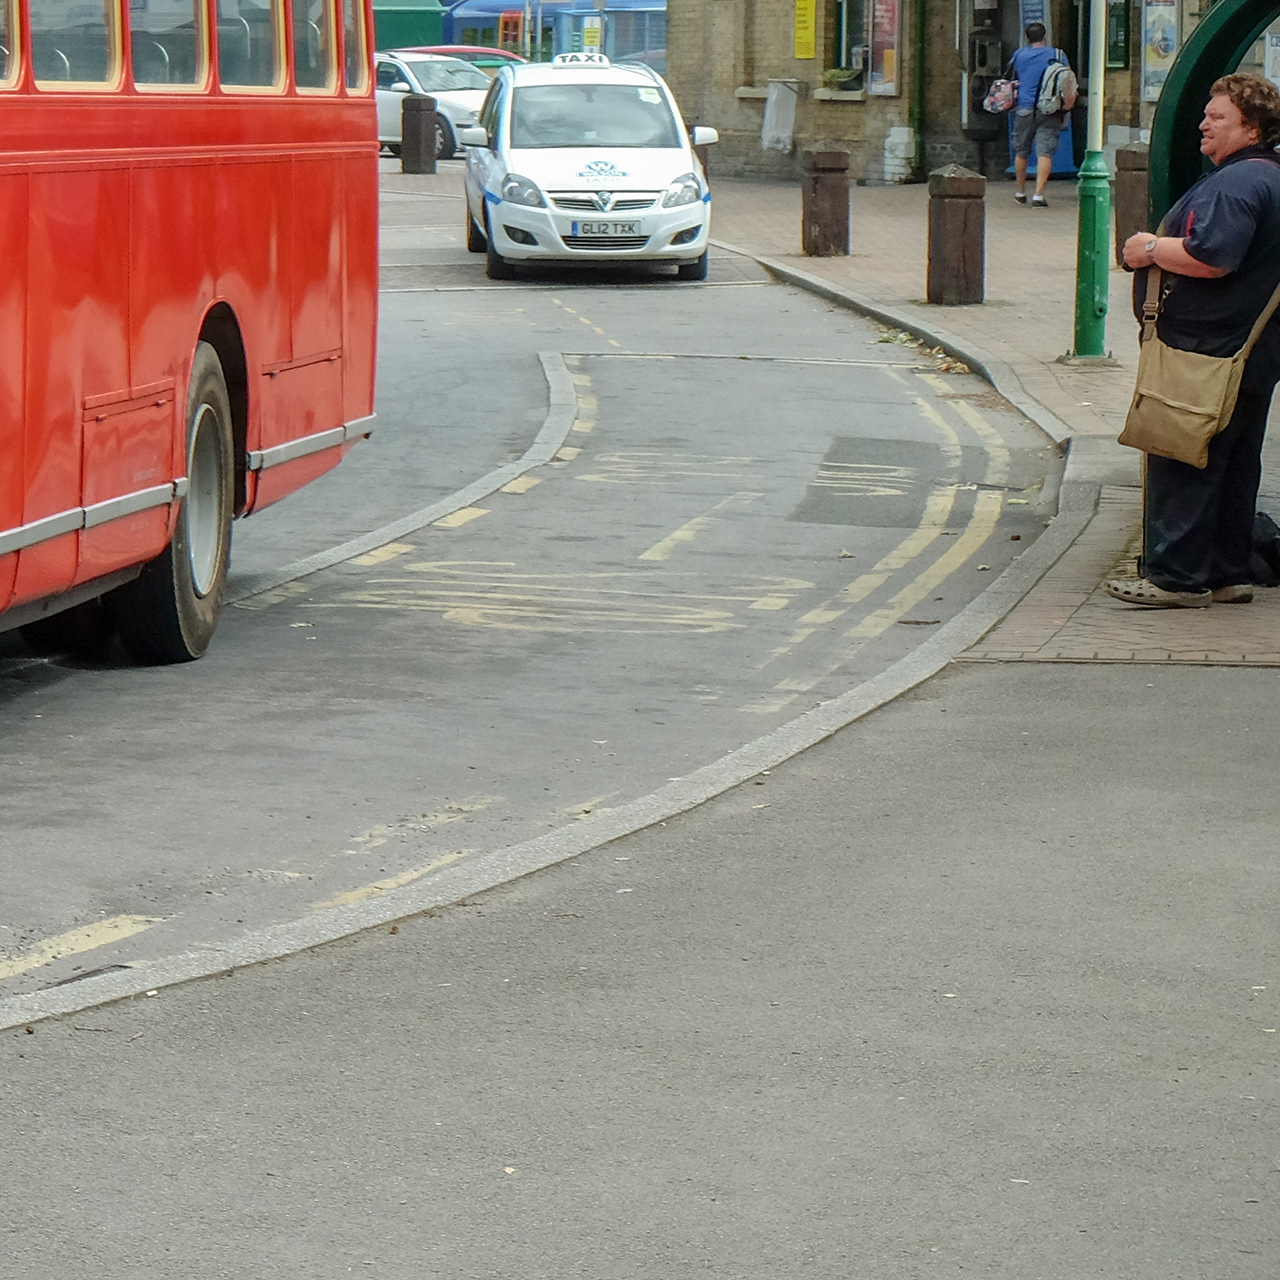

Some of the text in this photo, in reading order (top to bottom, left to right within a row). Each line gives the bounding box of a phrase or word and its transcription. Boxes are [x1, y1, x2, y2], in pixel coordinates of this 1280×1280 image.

[558, 54, 604, 64] TAXI
[582, 223, 636, 234] GL12 TXK
